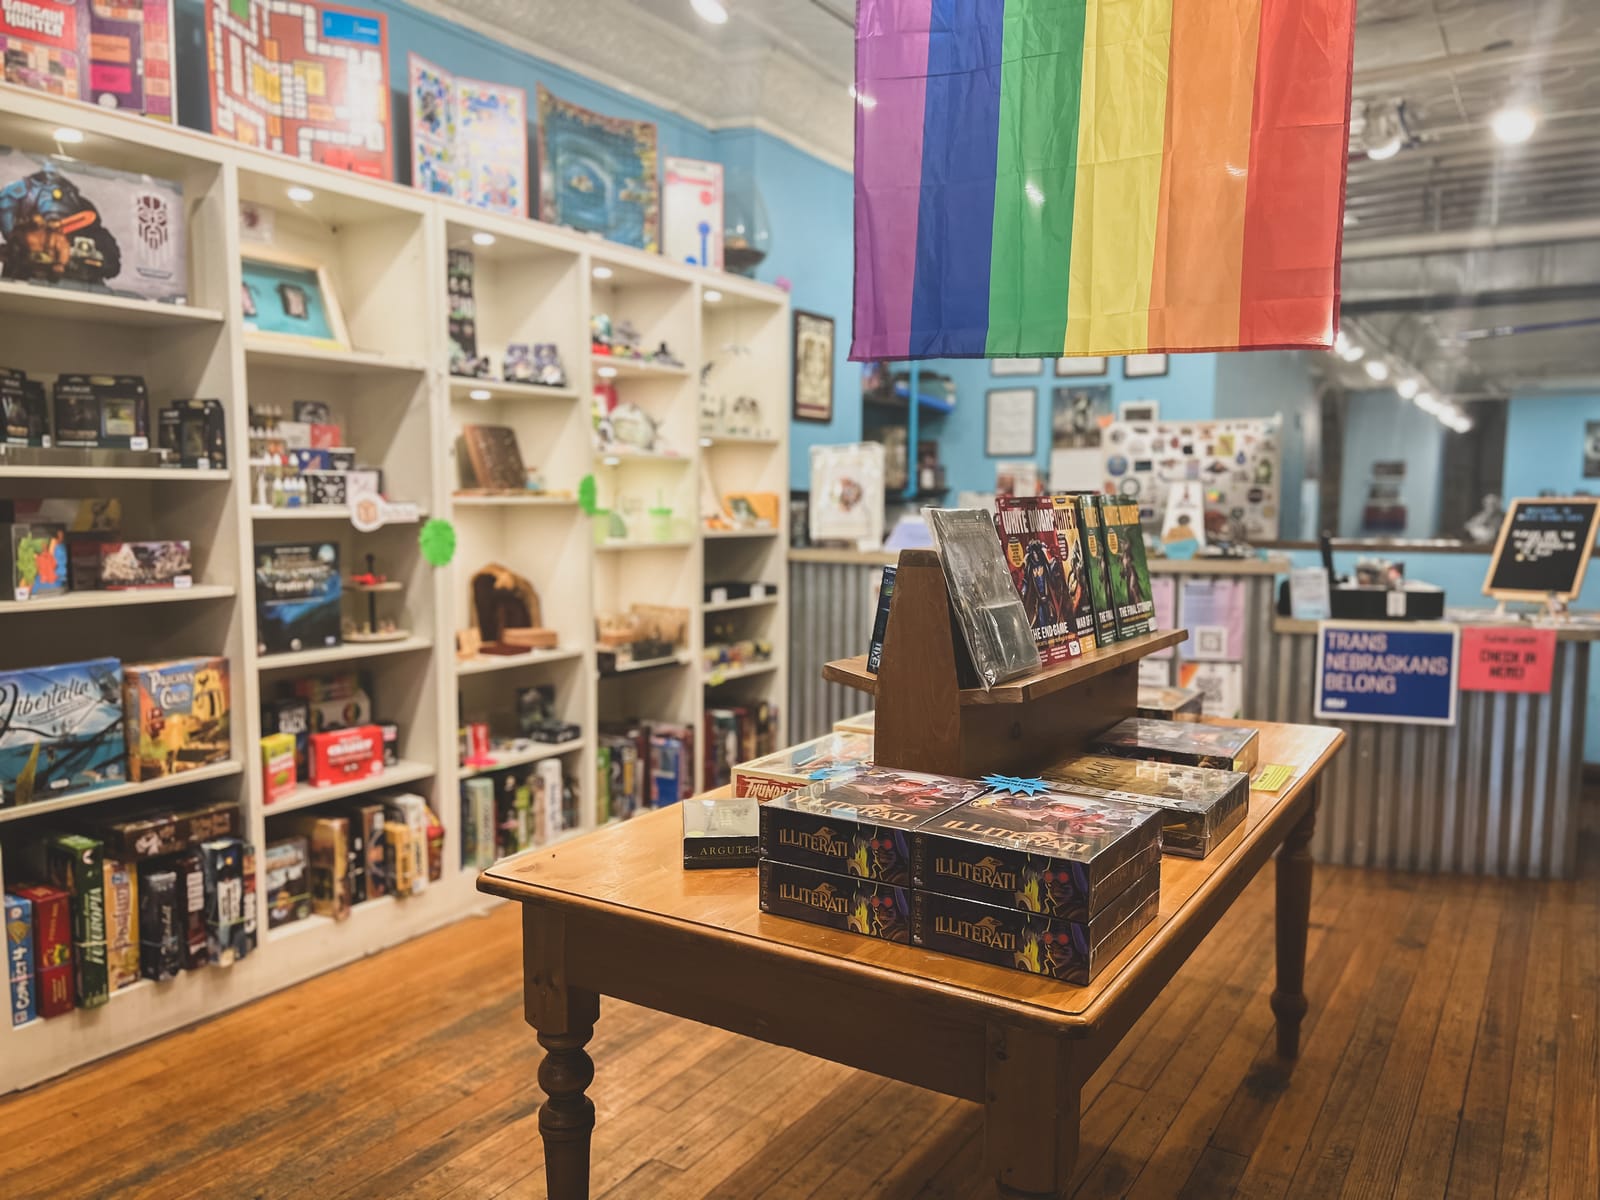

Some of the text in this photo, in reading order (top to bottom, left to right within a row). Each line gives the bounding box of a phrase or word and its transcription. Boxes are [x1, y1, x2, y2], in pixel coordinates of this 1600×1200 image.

[5, 10, 63, 37] HUNTER
[1001, 508, 1054, 534] WHITE DWARF
[870, 642, 882, 667] EXIT
[1327, 632, 1387, 652] TRANS
[1326, 652, 1449, 676] NEBRASKANS
[1325, 672, 1396, 694] BELONG
[779, 827, 849, 858] ILLITERATI
[943, 819, 1092, 852] ILLITERATI
[935, 857, 1017, 890] ILLITERATI
[779, 884, 849, 914] ILLITERATI
[935, 916, 1017, 950] ILLITERATI
